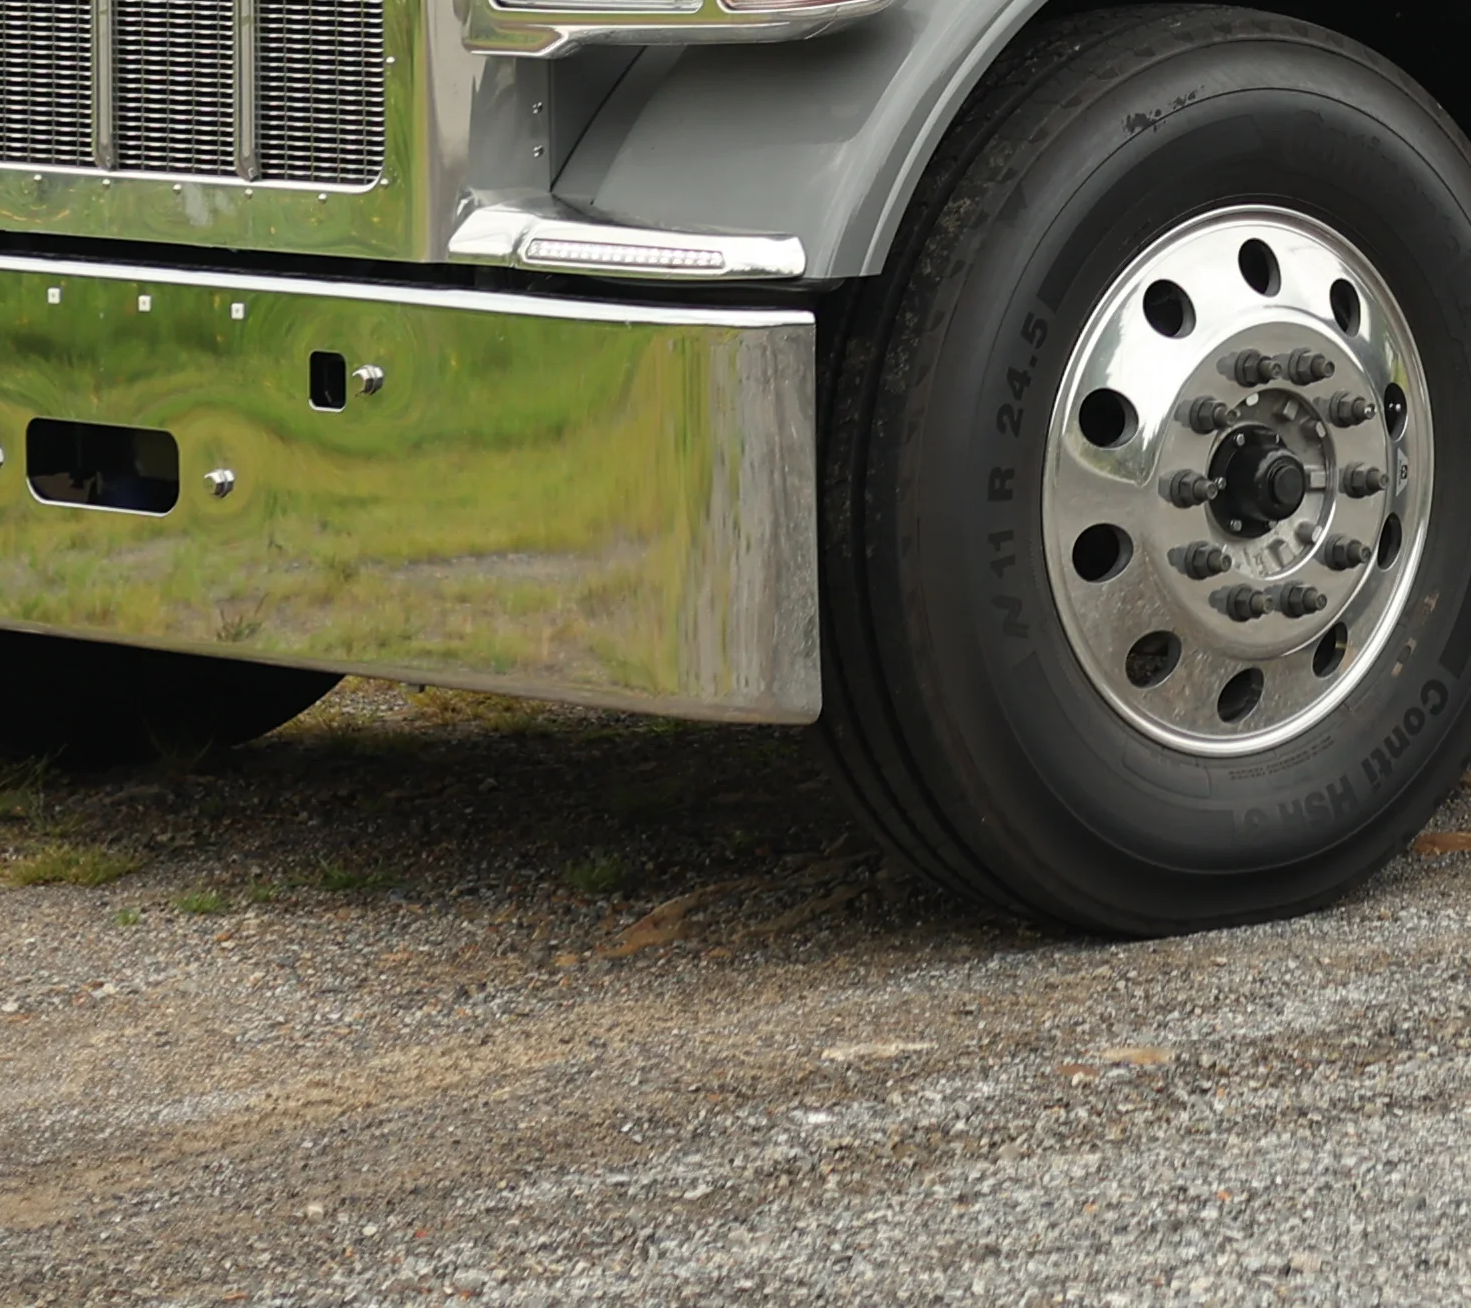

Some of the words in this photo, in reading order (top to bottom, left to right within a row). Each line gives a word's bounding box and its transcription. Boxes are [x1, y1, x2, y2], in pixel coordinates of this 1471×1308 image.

[995, 311, 1049, 438] 24.5
[987, 465, 1016, 503] R
[987, 528, 1017, 579] 11
[1360, 679, 1449, 791] Conti
